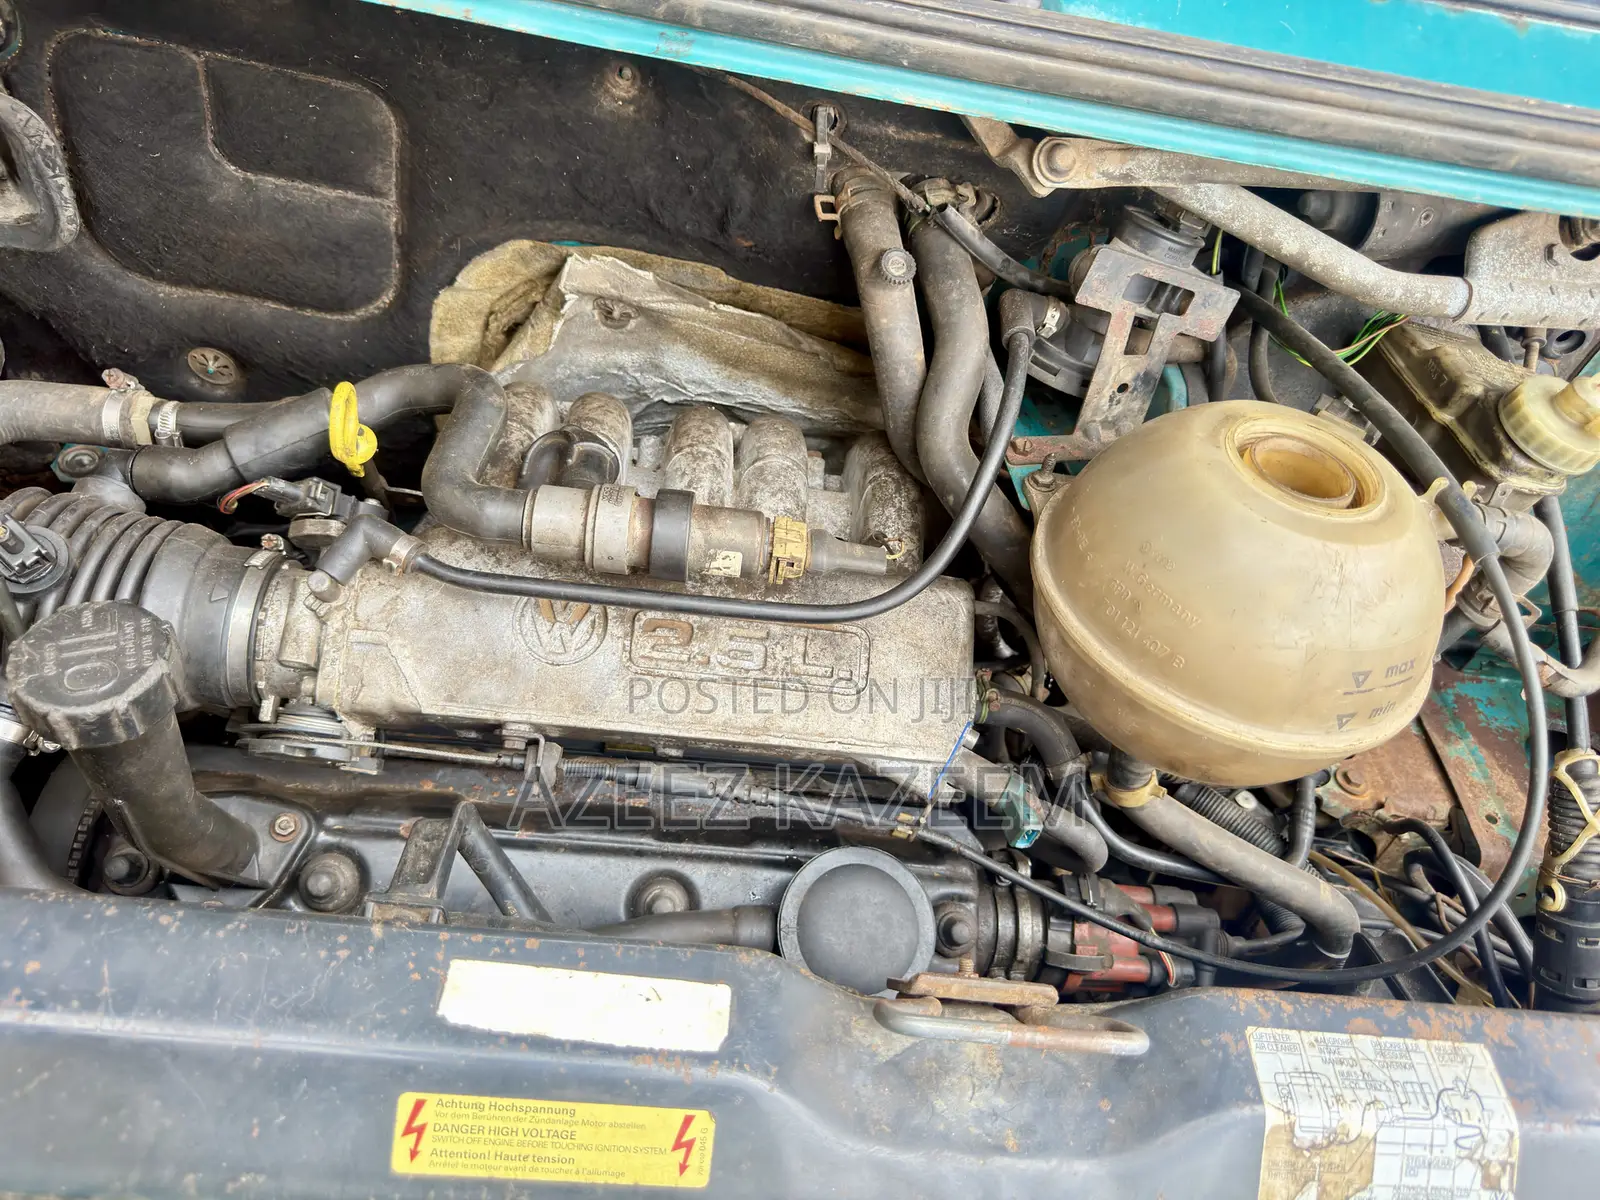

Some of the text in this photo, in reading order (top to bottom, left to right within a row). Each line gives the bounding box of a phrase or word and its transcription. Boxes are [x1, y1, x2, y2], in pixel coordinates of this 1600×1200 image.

[58, 609, 121, 696] OIL
[1384, 658, 1416, 678] max
[1368, 701, 1396, 719] min
[436, 1098, 576, 1117] Achtung Hochspannung
[434, 1110, 449, 1118] Vor
[472, 1113, 511, 1122] Berühren
[513, 1115, 527, 1123] der
[529, 1116, 579, 1127] Zündanlage
[581, 1119, 606, 1128] Motor
[608, 1120, 646, 1130] abstellen
[433, 1122, 576, 1140] DANGER HIGH VOLTAGE
[431, 1135, 667, 1155] SWITCH OFF ENGINE BEFORE TOUCHING IGNITION SYSTEM
[430, 1148, 576, 1165] Attention! Haute tension
[470, 1163, 502, 1172] moteur
[541, 1166, 573, 1175] toucher
[582, 1168, 626, 1179] l'allumage
